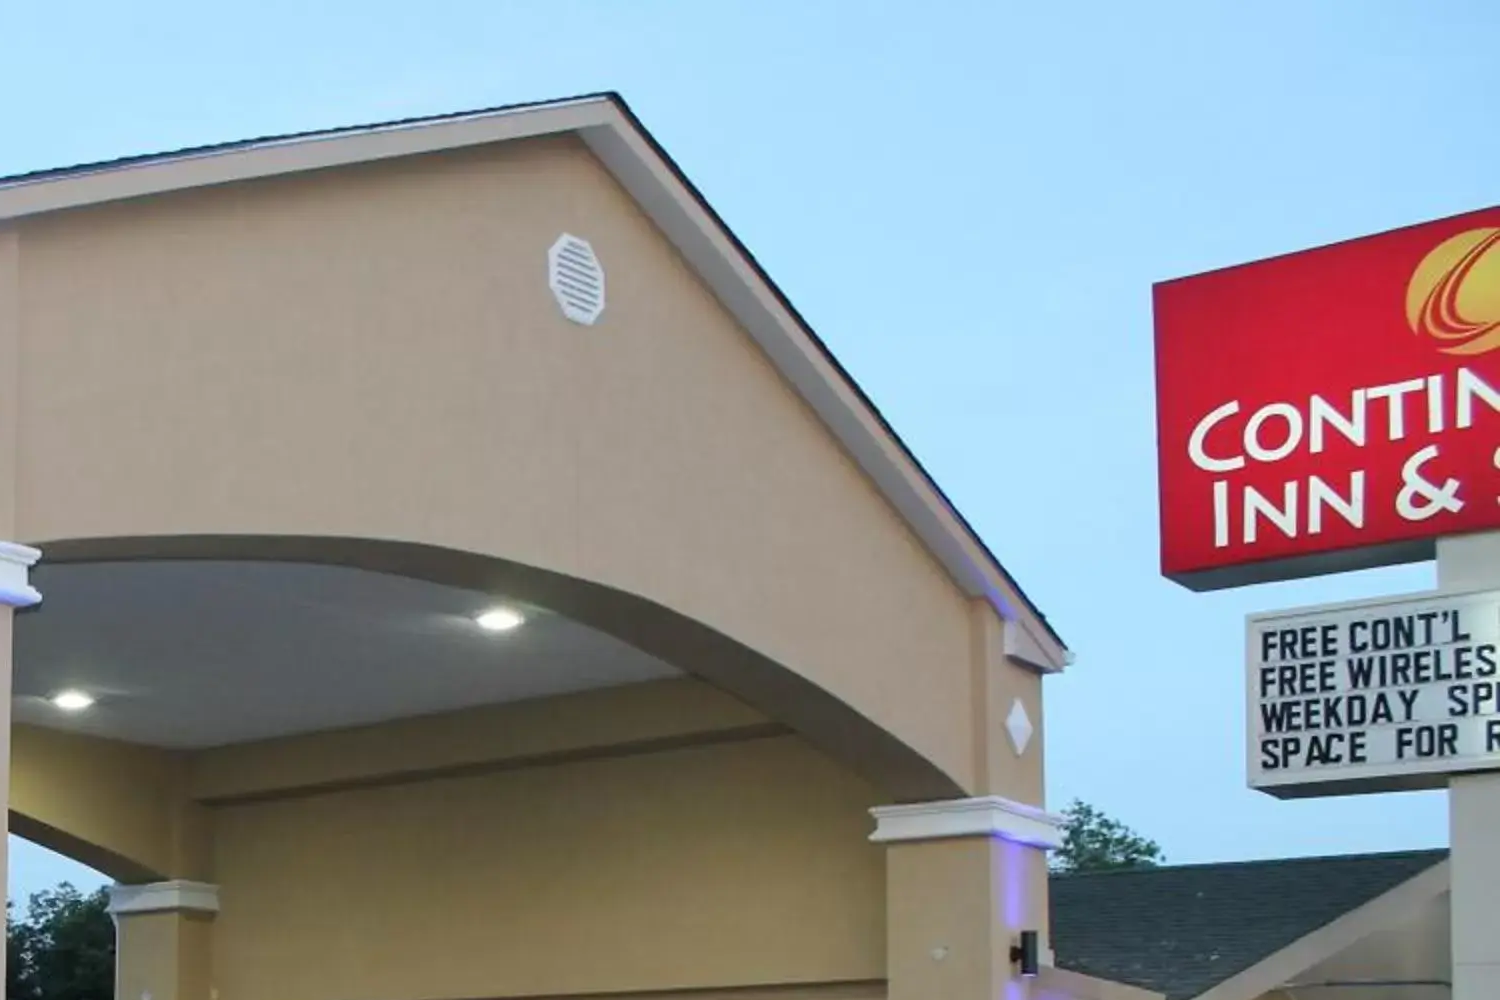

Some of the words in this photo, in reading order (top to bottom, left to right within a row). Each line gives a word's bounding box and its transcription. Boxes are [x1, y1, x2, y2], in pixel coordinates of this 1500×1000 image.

[1188, 367, 1500, 471] CONTIN
[1213, 470, 1364, 548] INN
[1396, 444, 1465, 521] &
[1262, 624, 1339, 662] FREE
[1349, 610, 1470, 653] CONT'L
[1260, 661, 1336, 698] FREE
[1260, 689, 1419, 733] WEEKDAY
[1448, 682, 1500, 717] SP
[1261, 732, 1367, 769] SPACE
[1396, 724, 1458, 759] FOR
